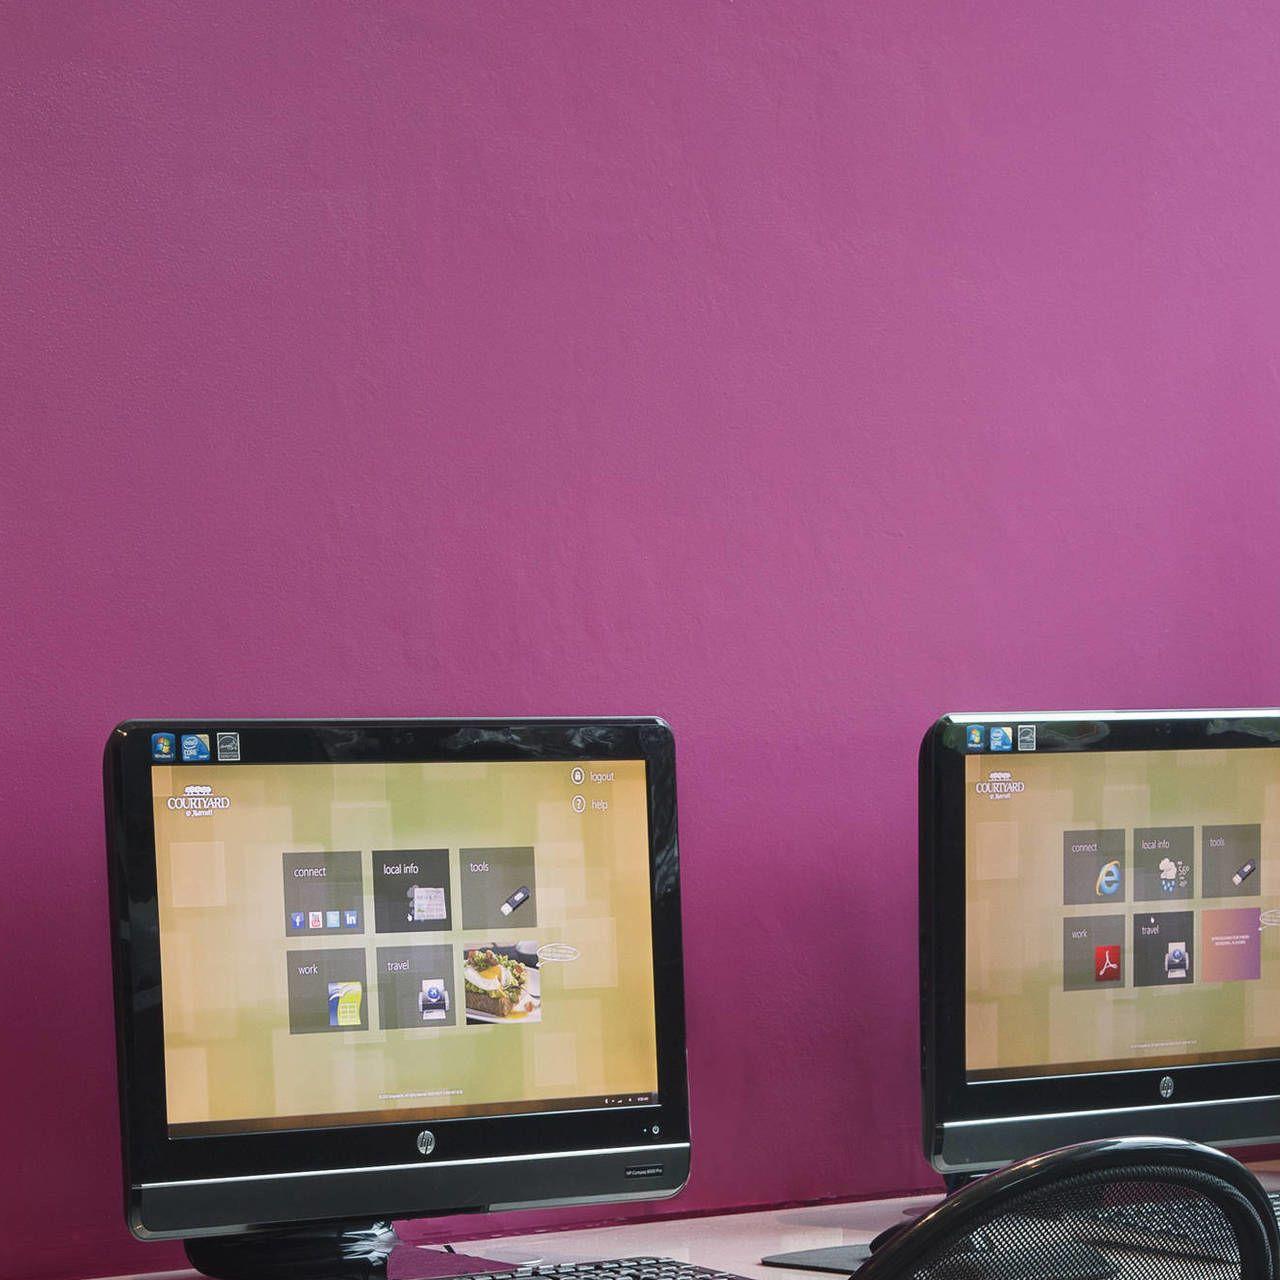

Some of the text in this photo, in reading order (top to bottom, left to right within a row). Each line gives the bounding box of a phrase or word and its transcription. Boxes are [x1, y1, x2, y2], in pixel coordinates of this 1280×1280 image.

[976, 782, 1025, 794] COURTYARD
[167, 798, 230, 810] COURTYARD
[1071, 844, 1097, 853] connect
[1141, 839, 1157, 850] local
[293, 866, 326, 877] connect
[383, 862, 419, 875] local info
[470, 861, 489, 872] tools
[1141, 925, 1159, 936] travel
[297, 964, 319, 975] work
[386, 959, 409, 971] travel
